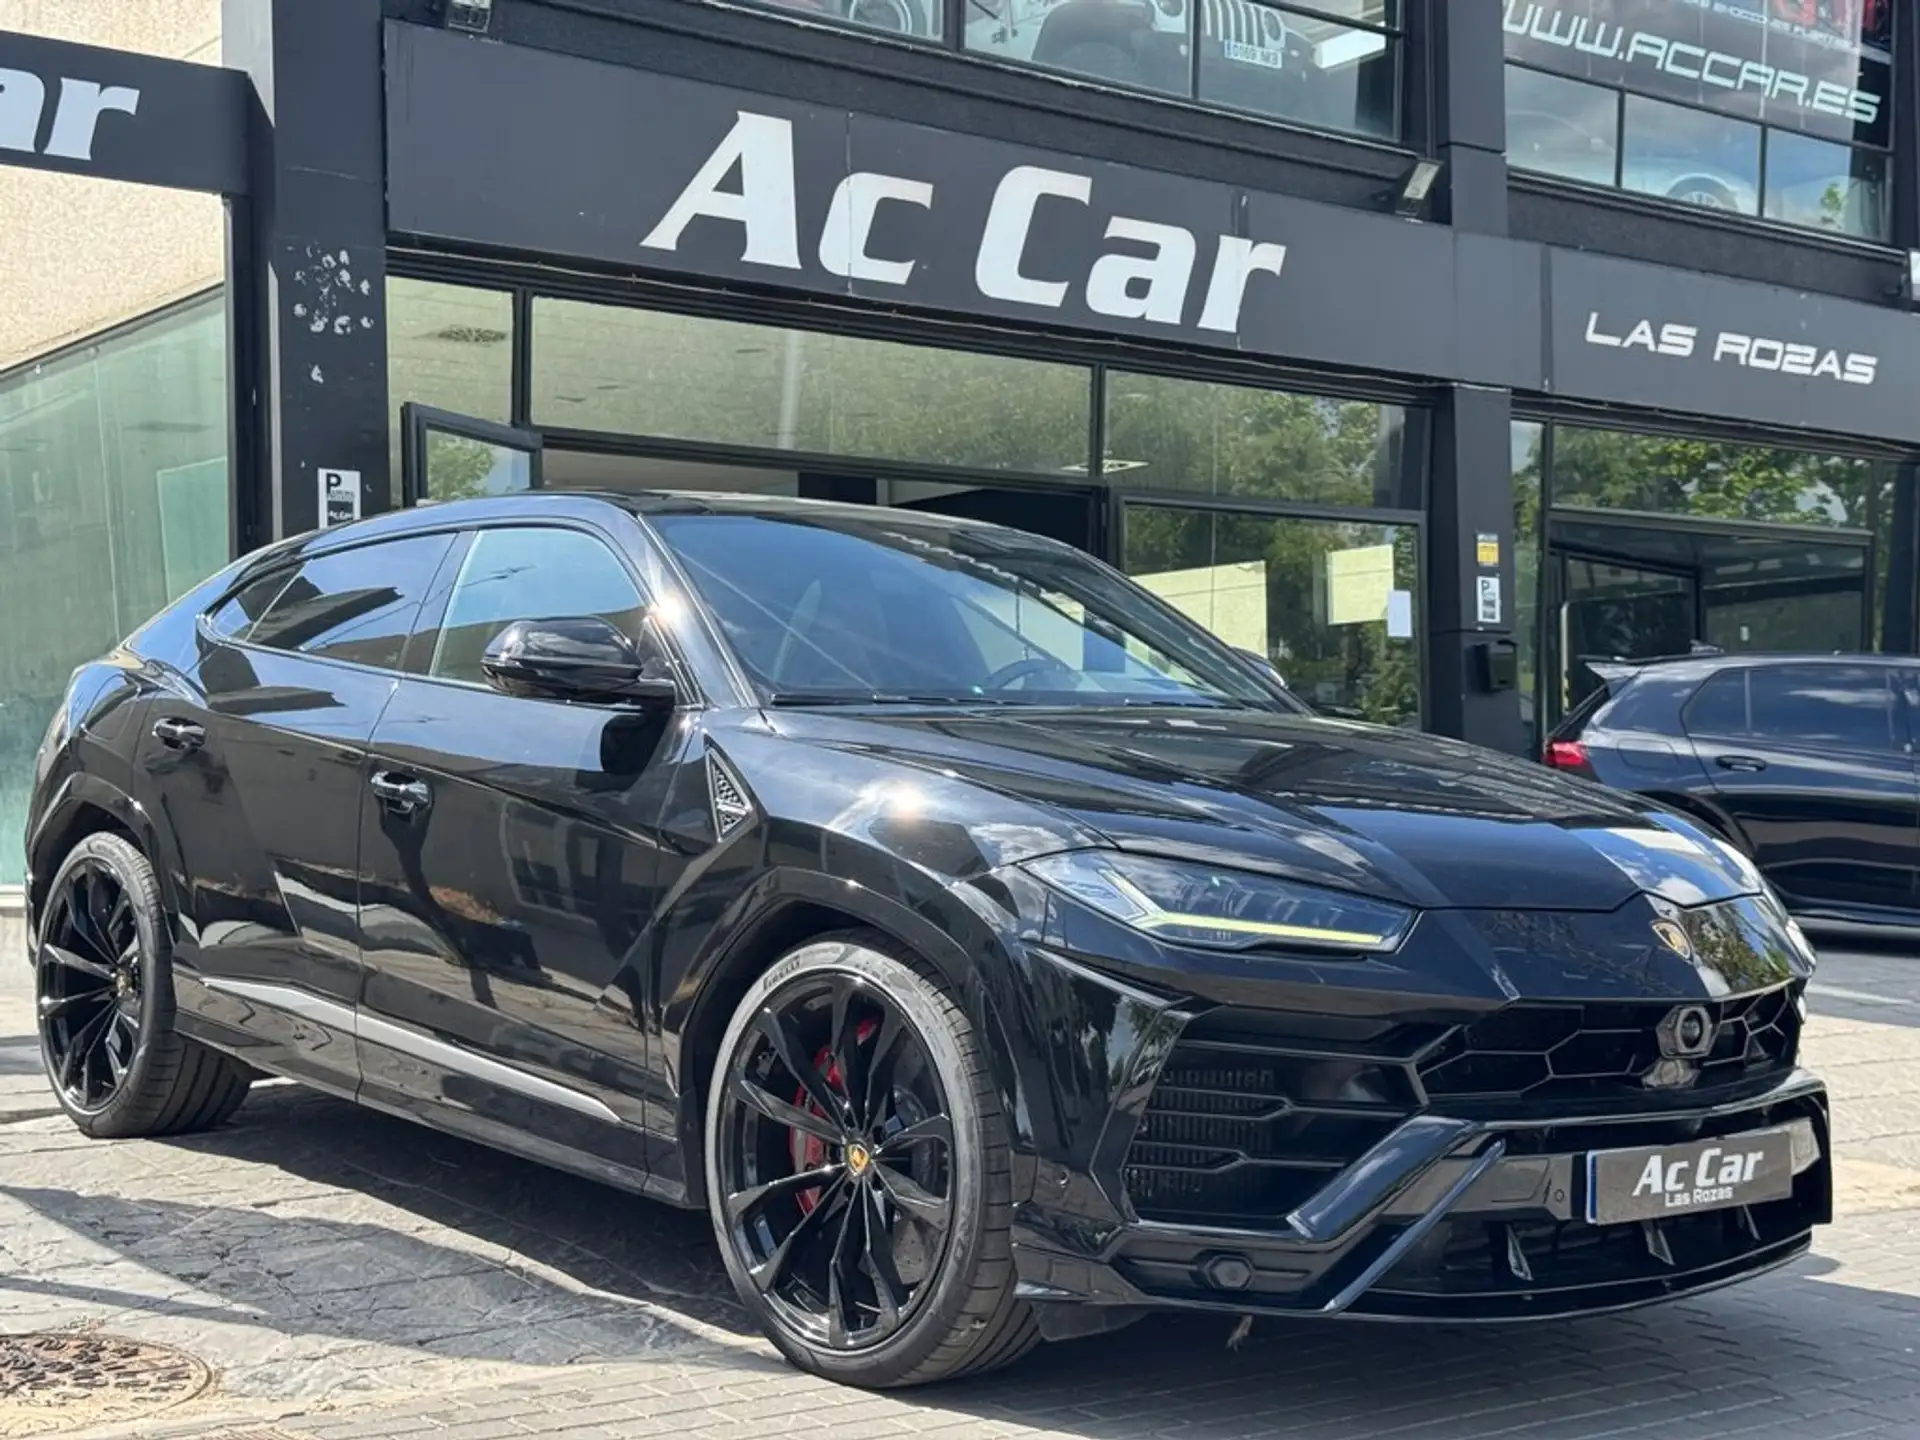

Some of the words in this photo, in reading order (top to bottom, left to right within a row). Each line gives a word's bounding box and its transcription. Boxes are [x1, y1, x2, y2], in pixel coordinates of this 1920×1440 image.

[639, 110, 934, 286] Ac
[975, 164, 1287, 334] Car
[1585, 311, 1698, 358] LAS
[1713, 331, 1879, 385] ROZAS
[326, 473, 342, 495] P
[1632, 1154, 1690, 1197] Ac
[1695, 1147, 1765, 1188] Car
[1664, 1190, 1691, 1208] Las
[1692, 1185, 1734, 1204] Rozas
